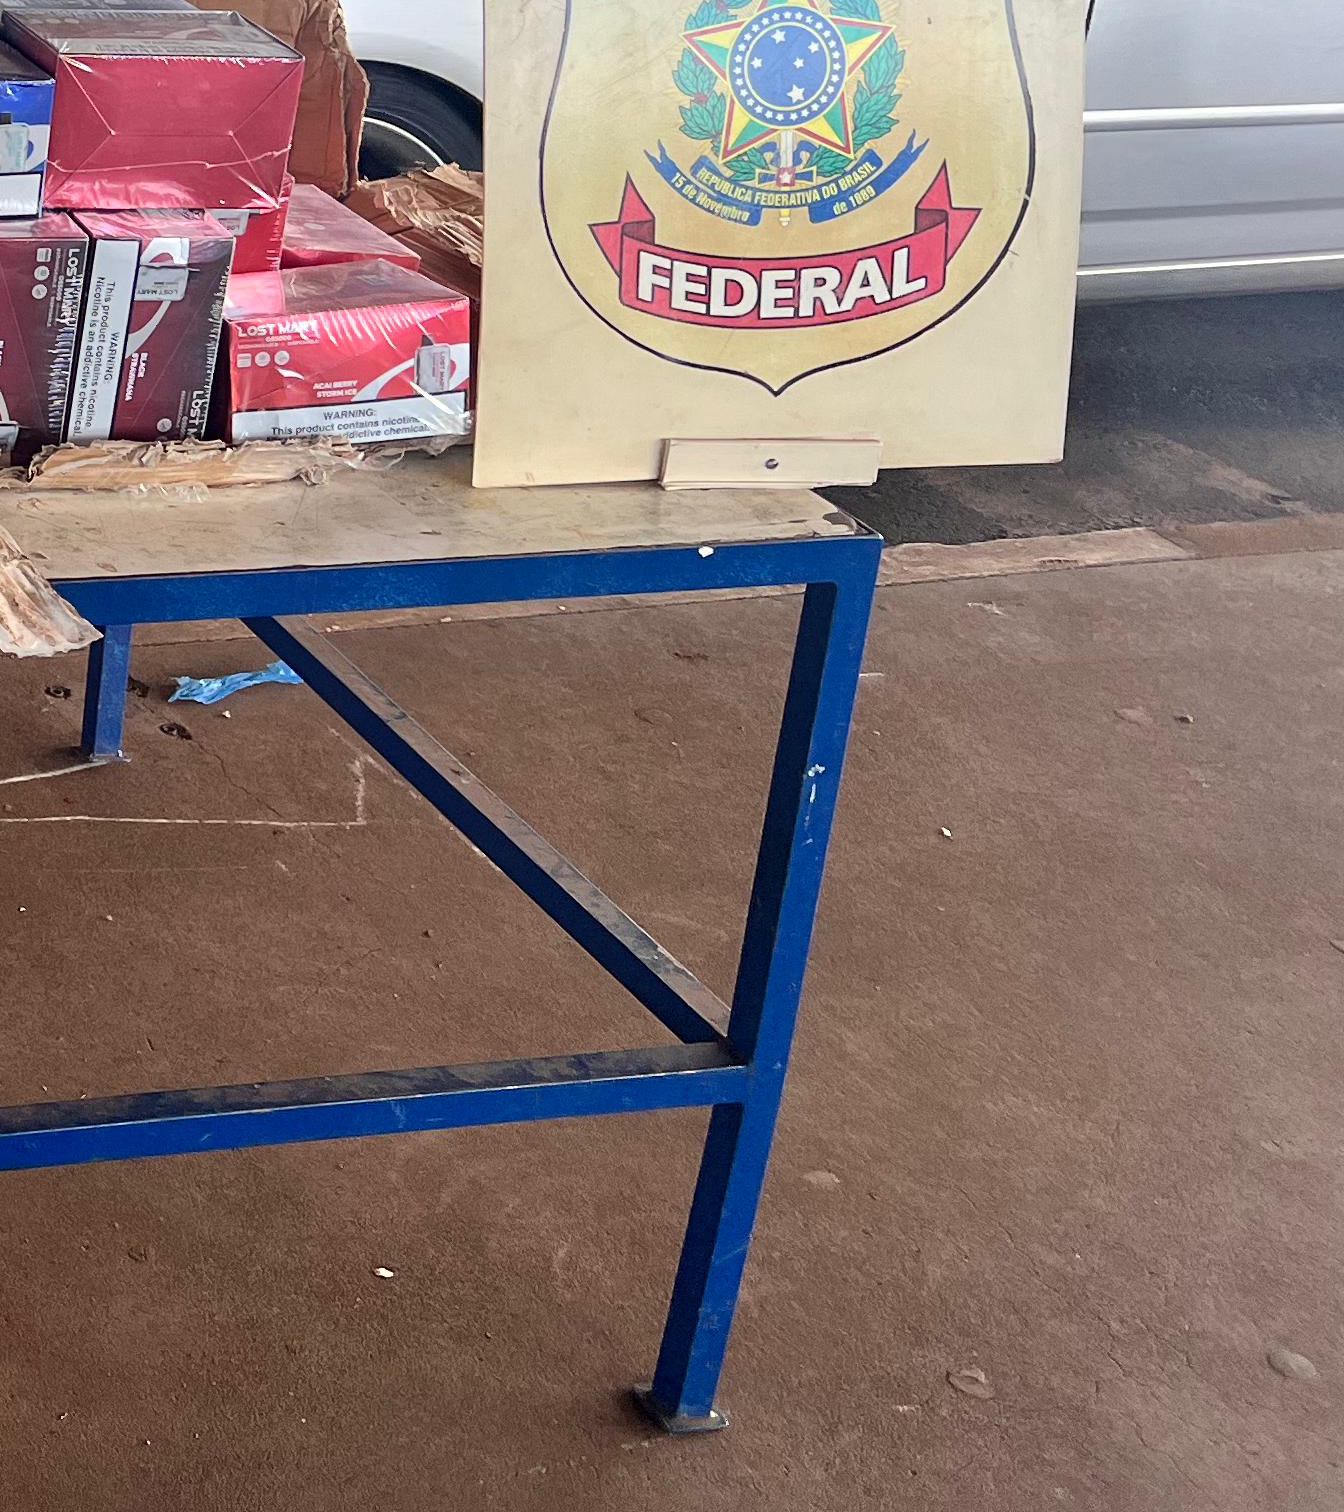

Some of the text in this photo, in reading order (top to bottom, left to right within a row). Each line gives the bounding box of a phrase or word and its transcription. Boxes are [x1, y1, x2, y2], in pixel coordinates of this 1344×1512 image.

[755, 189, 821, 207] FEDERATIVA
[822, 184, 837, 199] DO
[839, 162, 877, 191] BRASIL
[671, 172, 750, 222] 15 de Novembro
[833, 201, 848, 215] de
[637, 249, 929, 321] FEDERAL
[238, 323, 275, 337] LOST
[189, 390, 204, 426] LOST
[323, 408, 376, 420] WARNING:
[272, 421, 379, 435] This product contains
[346, 429, 381, 439] ddictive
